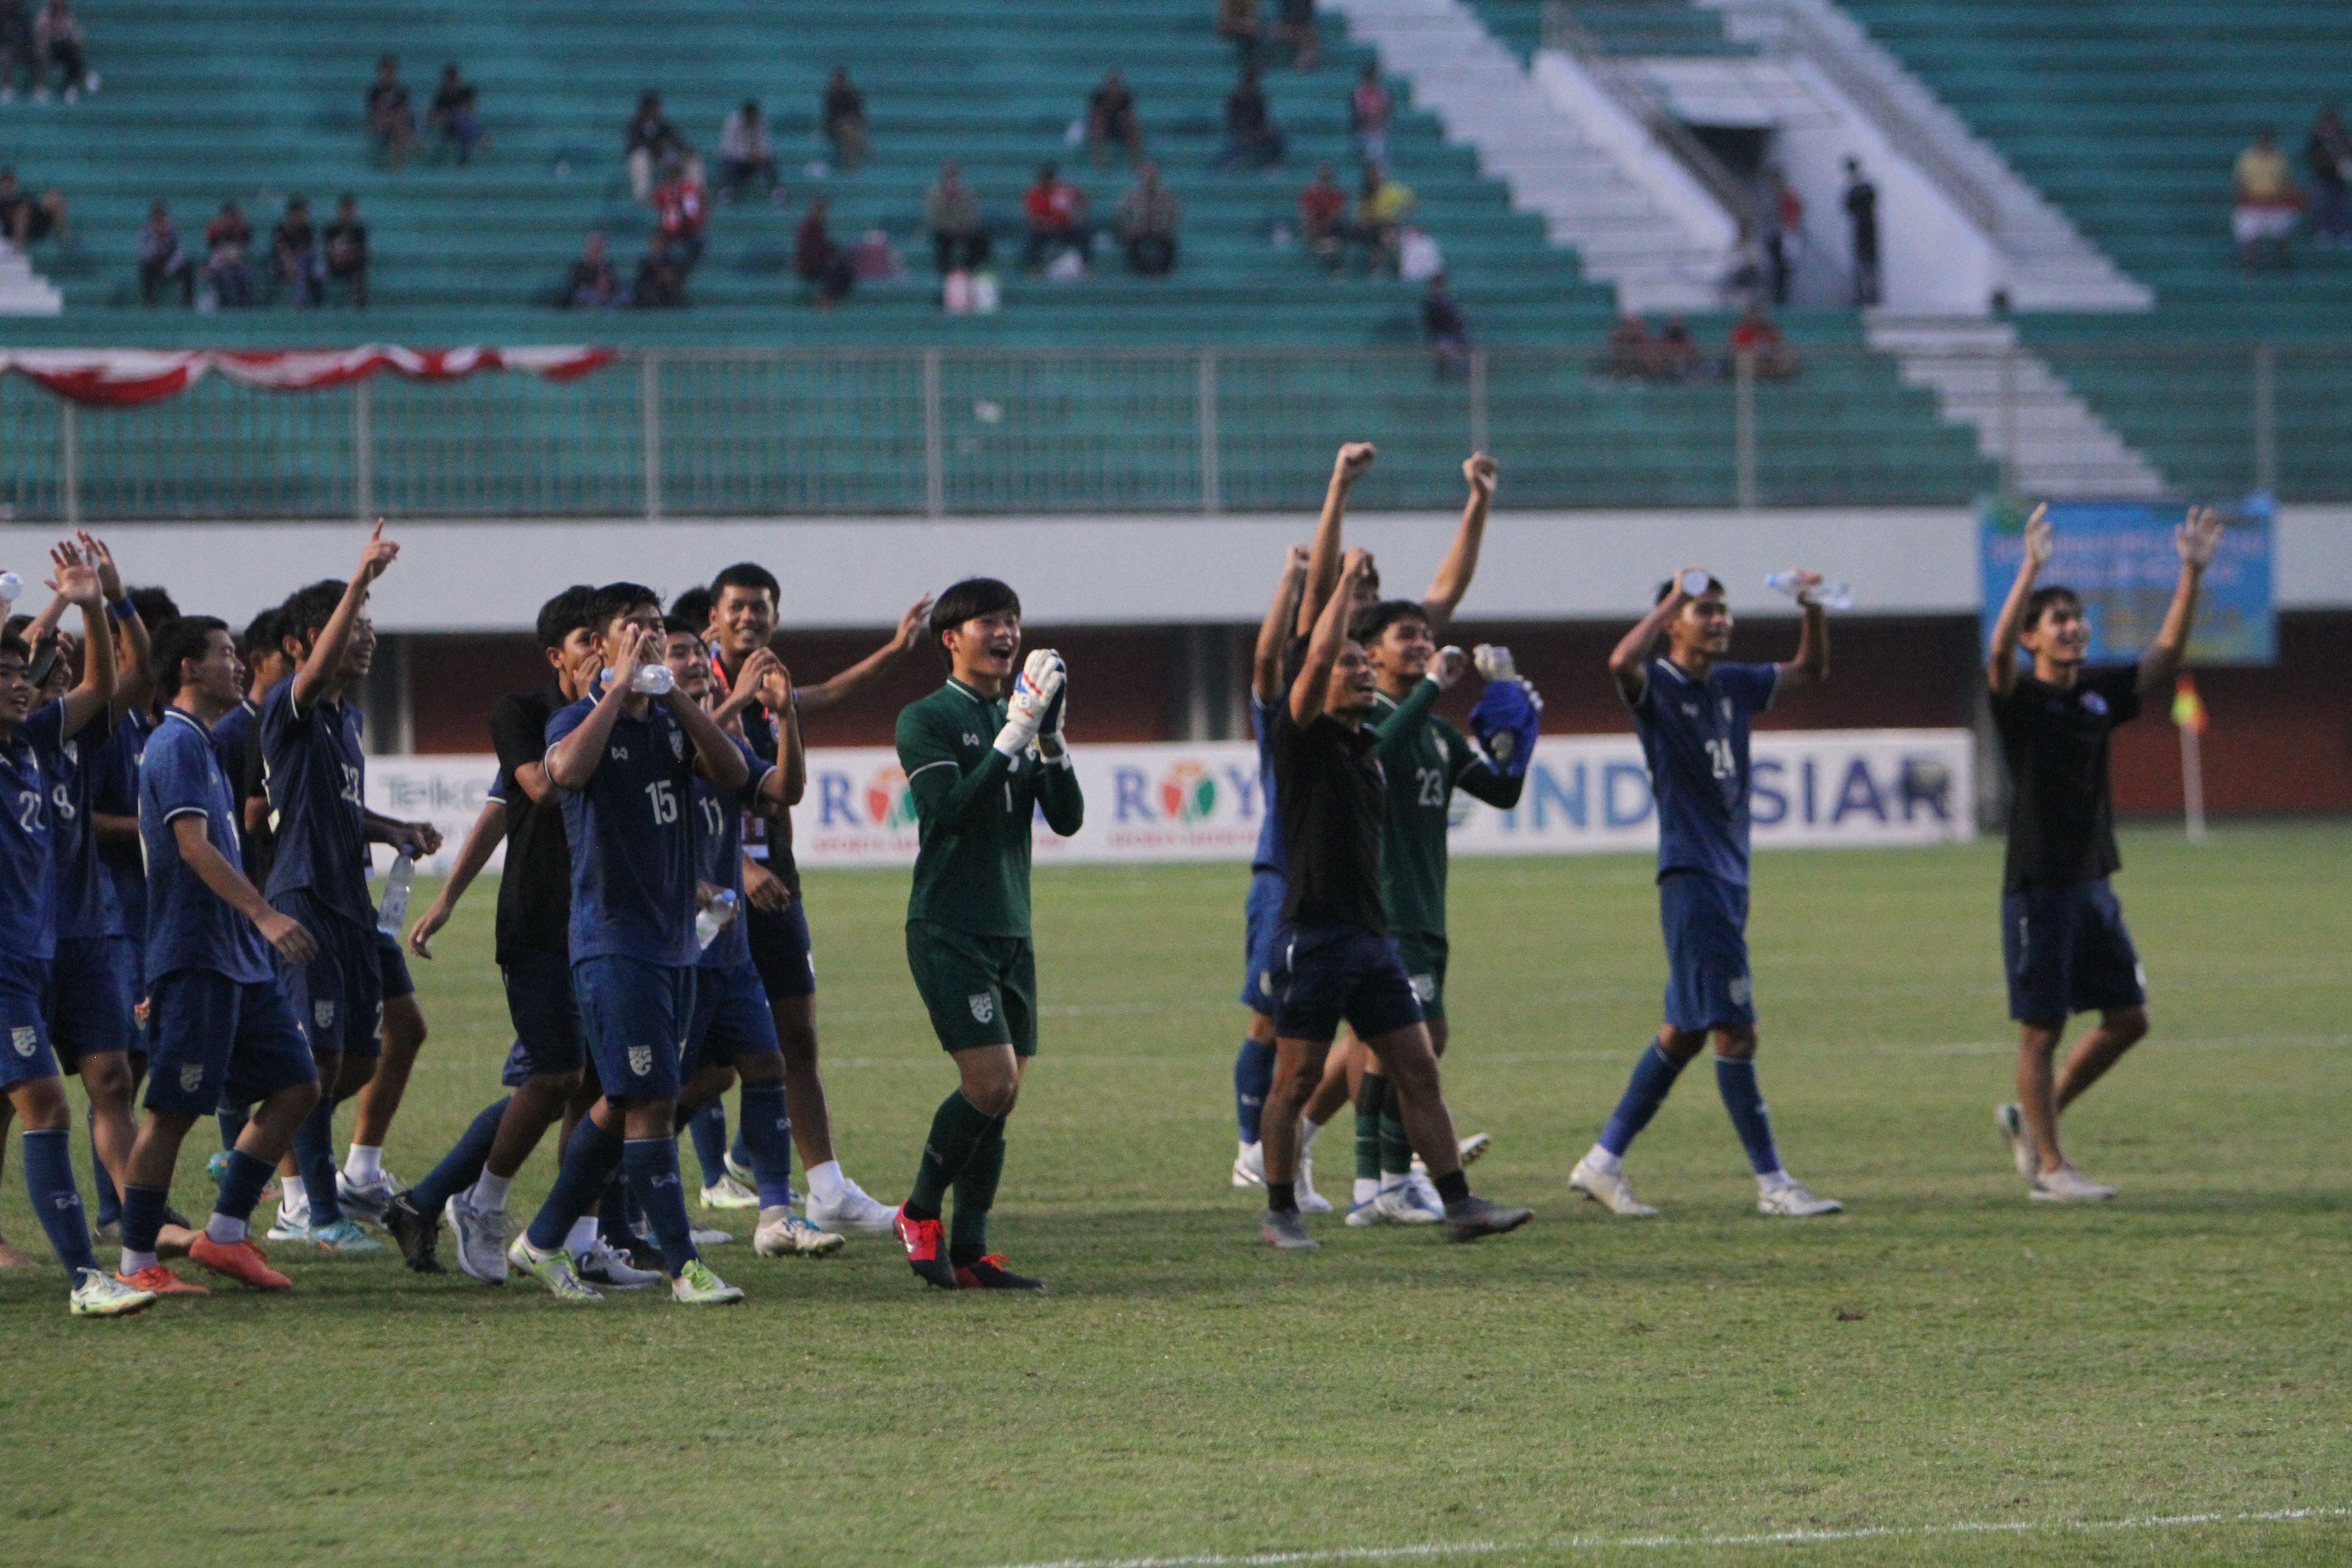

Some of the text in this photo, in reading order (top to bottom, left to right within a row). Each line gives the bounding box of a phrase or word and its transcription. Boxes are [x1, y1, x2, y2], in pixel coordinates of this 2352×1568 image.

[1705, 737, 1737, 779] 24
[645, 780, 678, 825] 15
[1416, 767, 1444, 807] 23
[699, 796, 723, 835] 11
